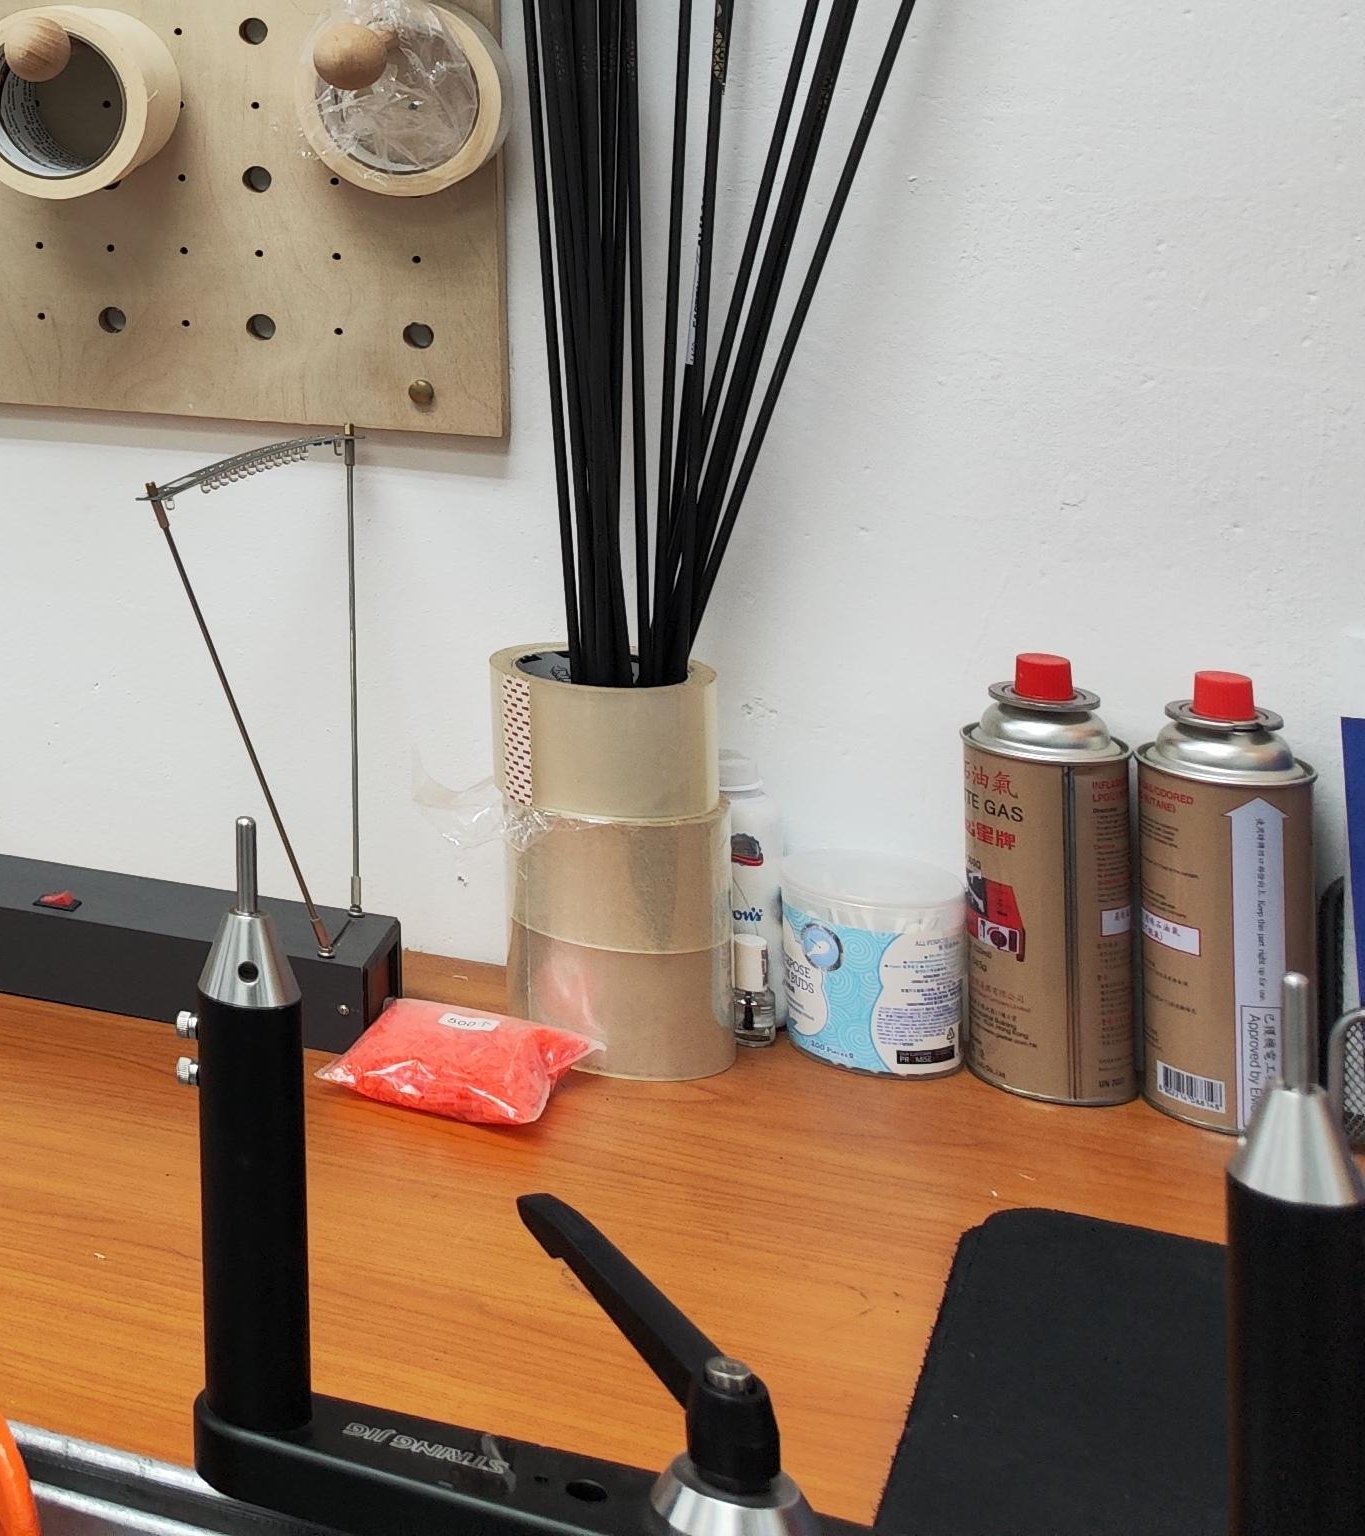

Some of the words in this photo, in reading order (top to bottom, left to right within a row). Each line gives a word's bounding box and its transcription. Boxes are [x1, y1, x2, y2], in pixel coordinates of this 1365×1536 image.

[984, 798, 1024, 823] GAS
[1256, 900, 1267, 918] Keep
[1246, 1013, 1262, 1069] Approved
[1249, 1070, 1262, 1084] by
[341, 1421, 396, 1446] JIG
[390, 1432, 513, 1476] STRING
